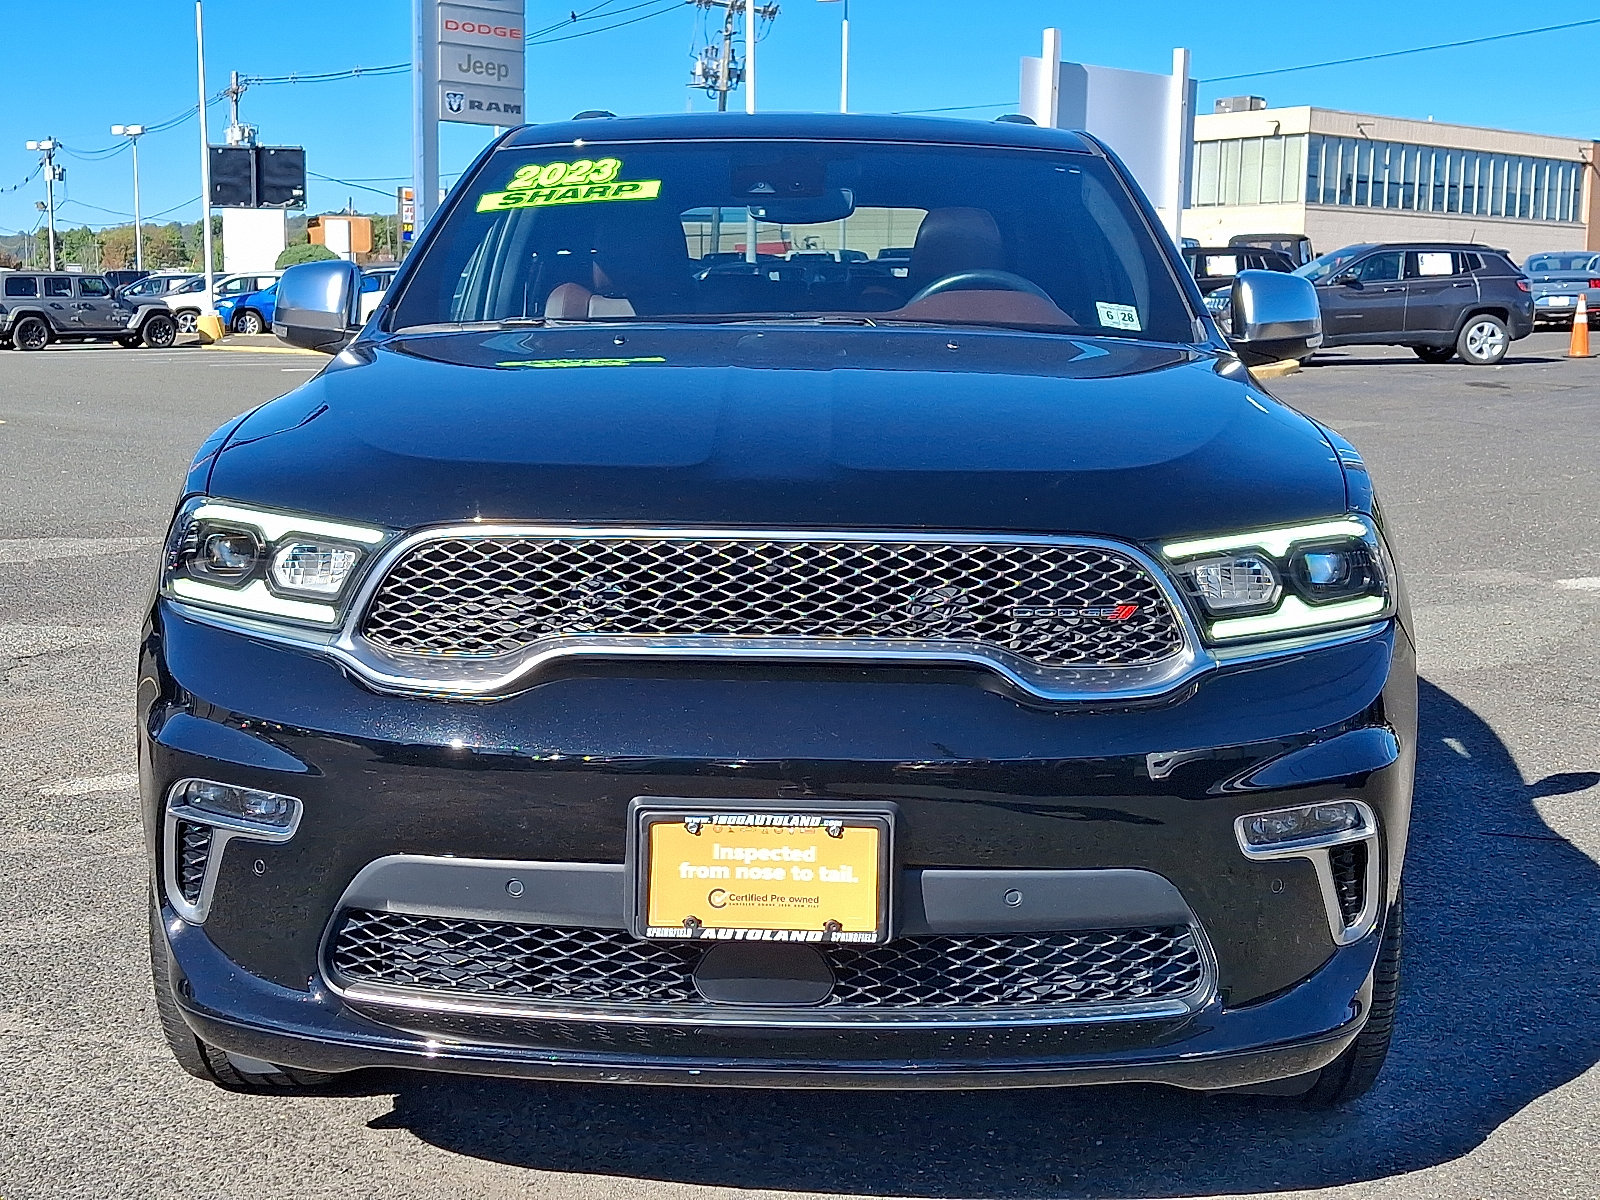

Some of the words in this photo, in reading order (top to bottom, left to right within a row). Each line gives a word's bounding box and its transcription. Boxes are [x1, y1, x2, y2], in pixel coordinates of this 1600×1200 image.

[445, 20, 521, 39] DODGE
[458, 54, 509, 81] Jeep
[469, 100, 521, 115] RAM
[505, 158, 624, 190] 2023
[498, 183, 641, 207] SHARP
[1106, 310, 1114, 320] 6
[1120, 312, 1135, 322] 28
[712, 843, 817, 864] Inspected
[679, 861, 730, 880] from
[735, 866, 787, 881] nose
[790, 865, 814, 882] to
[818, 864, 859, 883] tail.
[728, 893, 768, 902] Certified
[770, 894, 786, 903] Pre
[788, 896, 819, 904] owned
[700, 928, 824, 942] AUTOLAND
